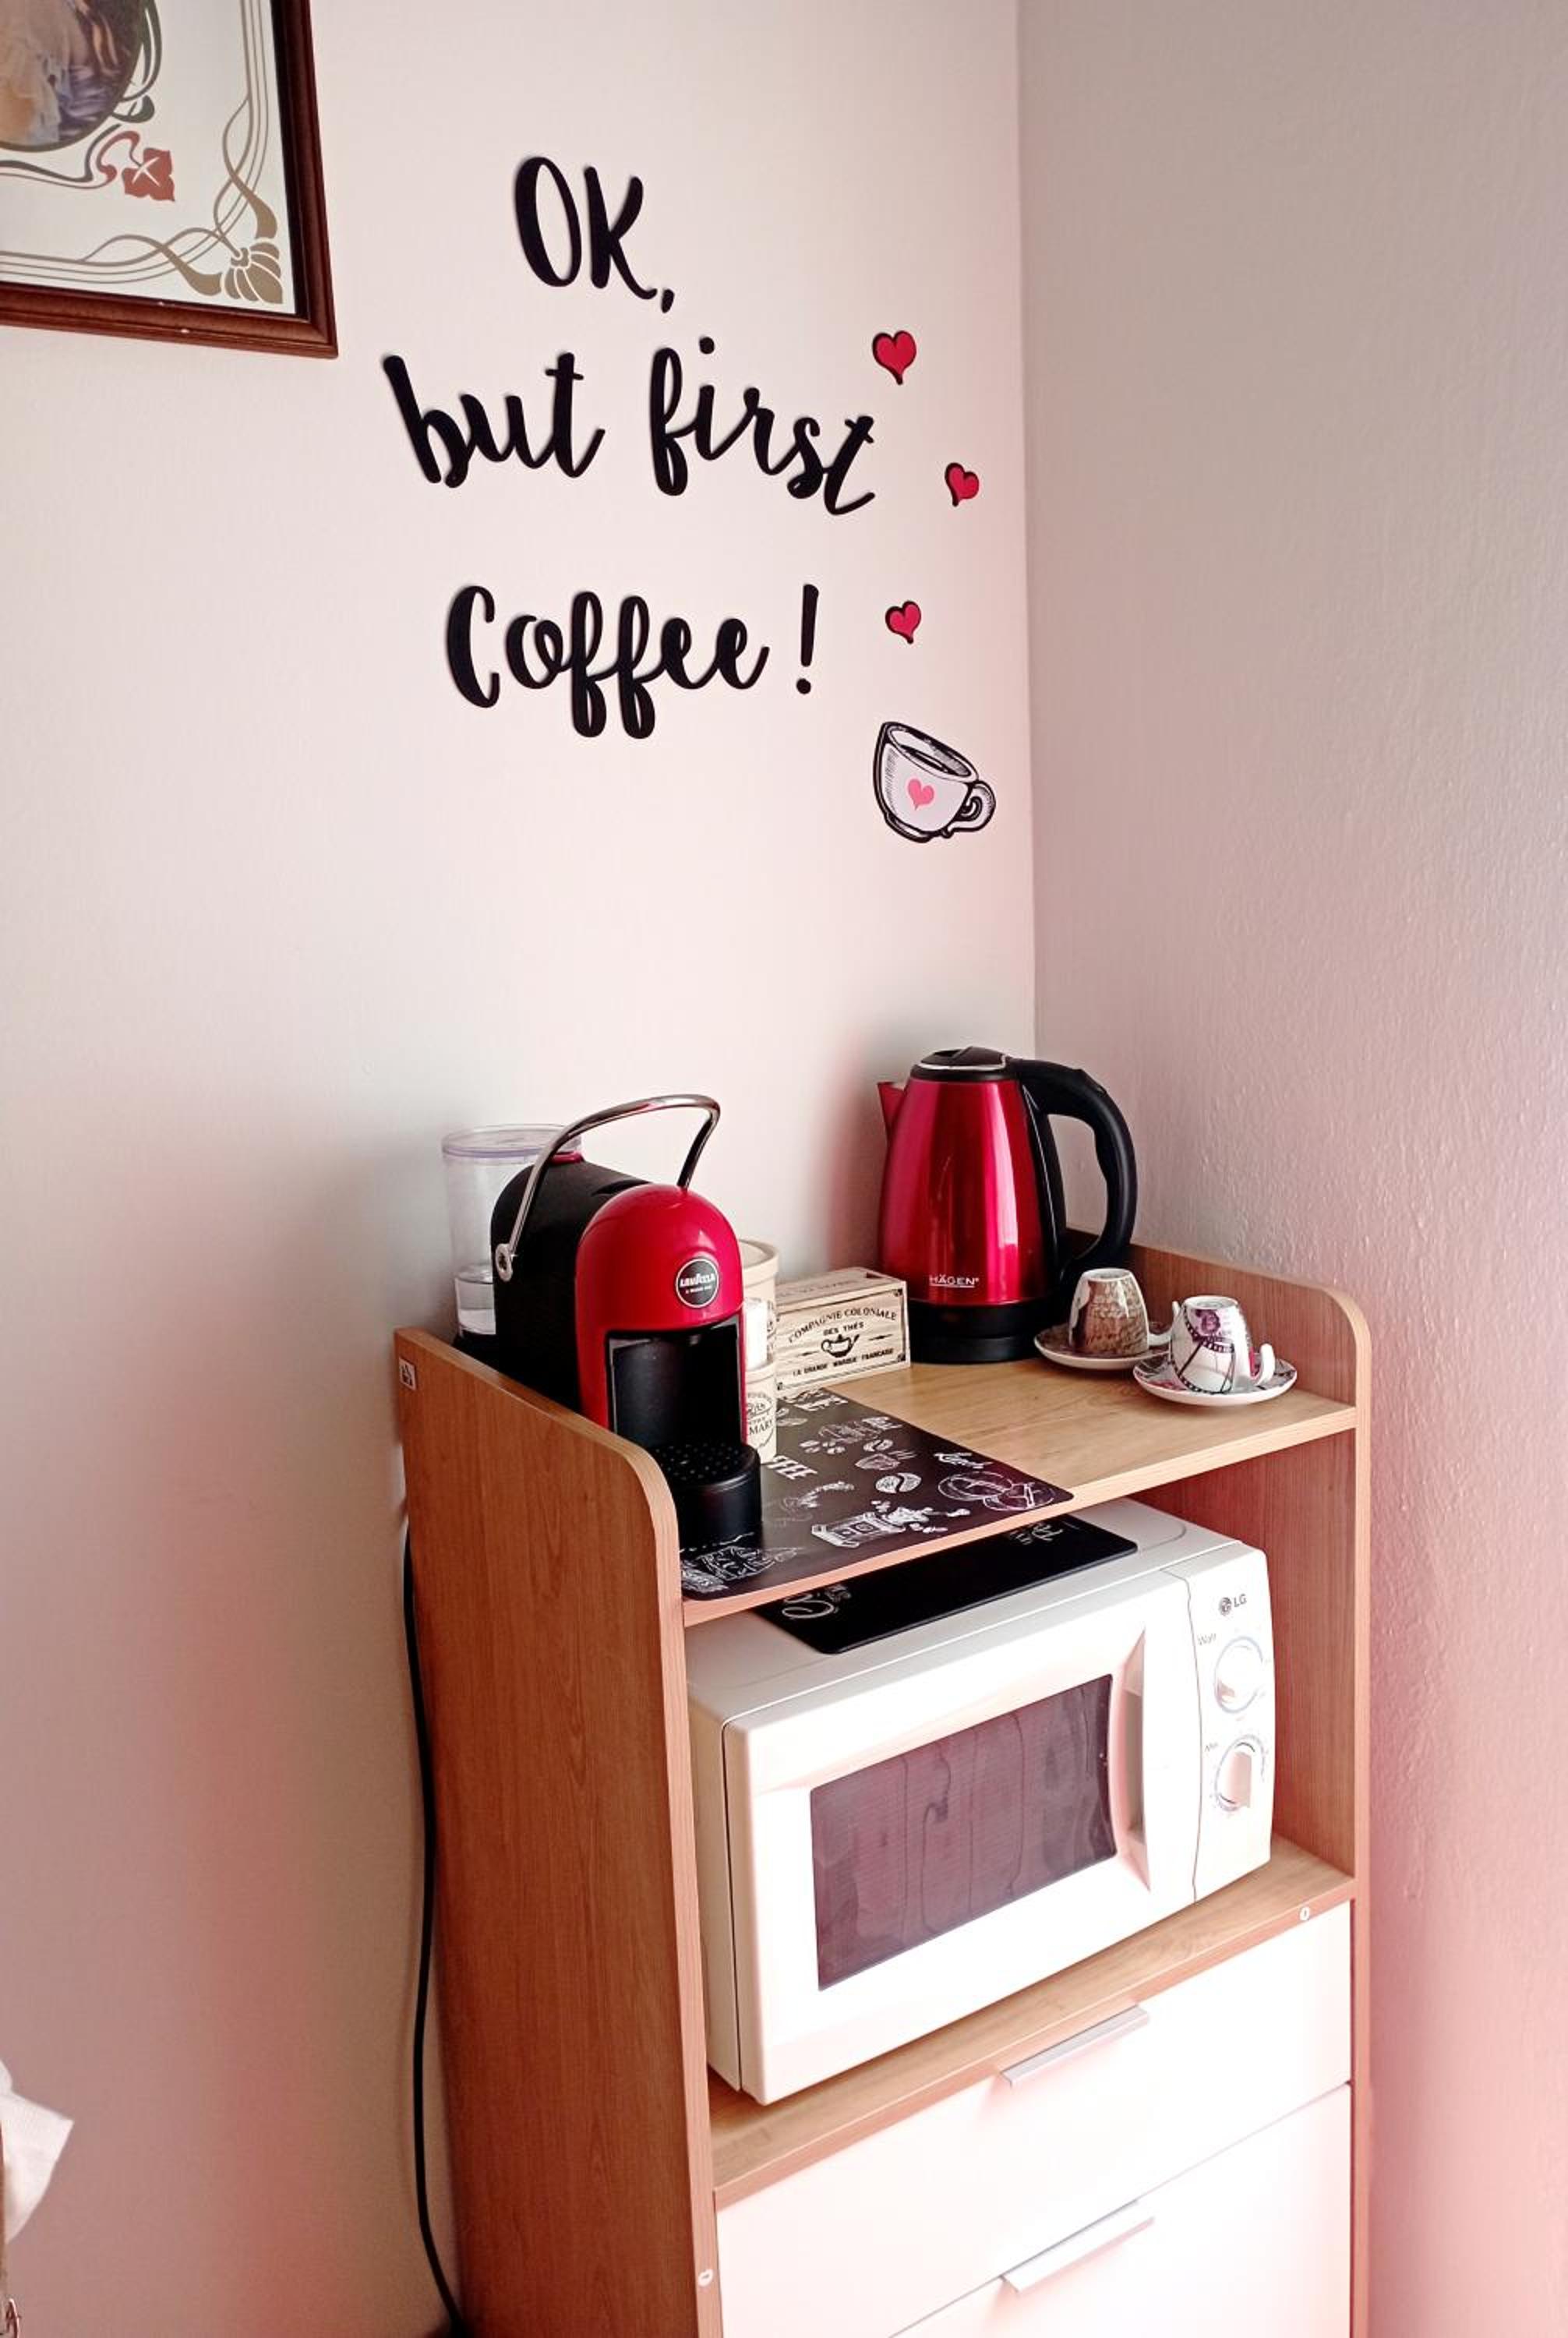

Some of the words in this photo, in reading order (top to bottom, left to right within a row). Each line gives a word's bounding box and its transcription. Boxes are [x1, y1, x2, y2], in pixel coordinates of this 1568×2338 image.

[514, 156, 675, 313] OK,
[382, 352, 606, 489] but
[649, 336, 875, 516] first
[446, 585, 770, 740] Coffee
[788, 1310, 842, 1343] COMPAGNIE
[844, 1307, 898, 1321] COLONIALE
[823, 1327, 839, 1336] DES
[1234, 1593, 1247, 1607] LG
